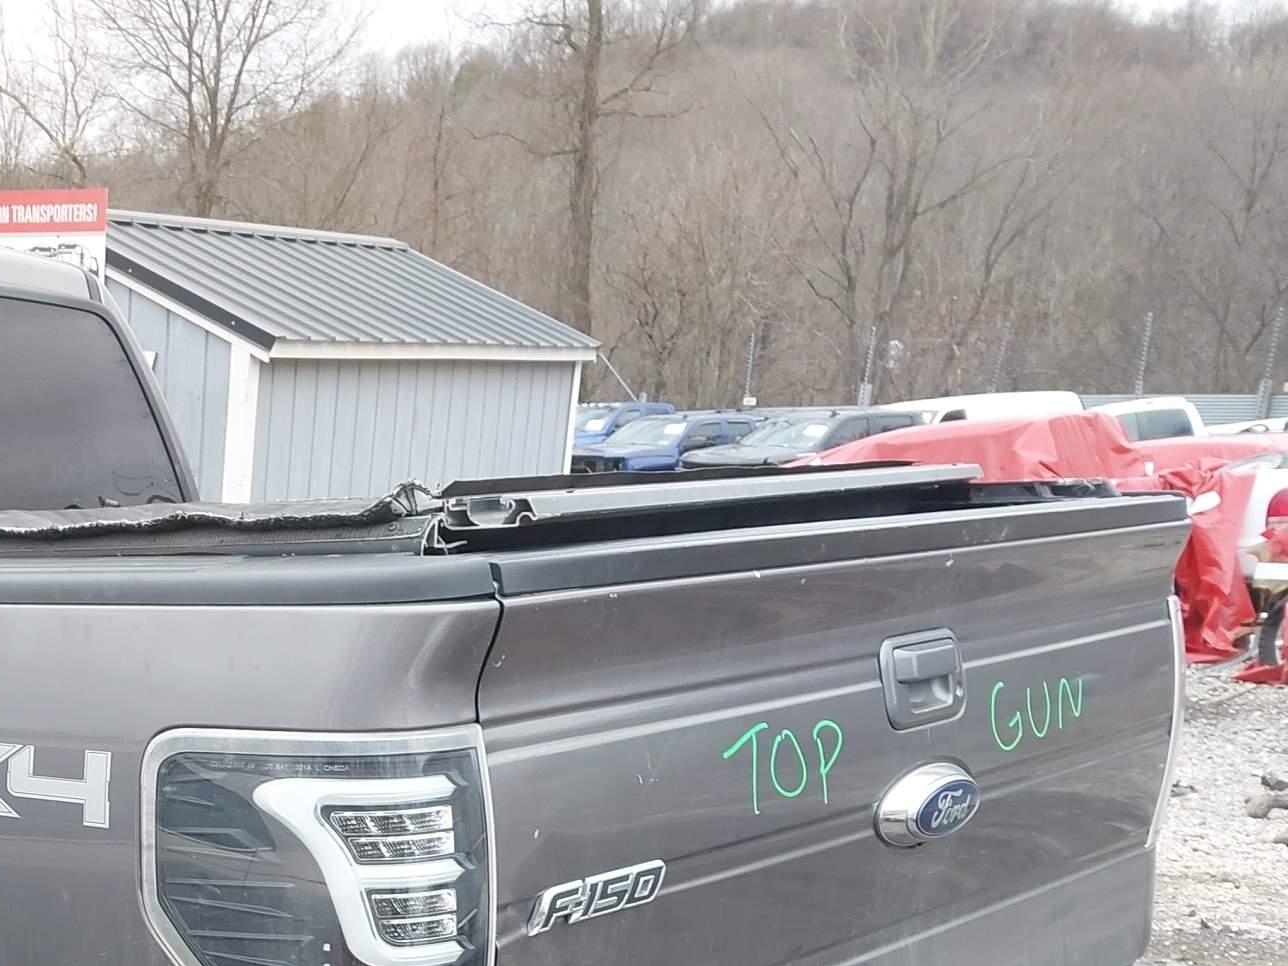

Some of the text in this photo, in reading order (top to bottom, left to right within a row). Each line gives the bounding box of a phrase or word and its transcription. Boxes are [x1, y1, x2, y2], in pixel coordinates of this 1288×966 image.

[11, 203, 98, 223] TRANSPORTERS!
[722, 676, 1084, 815] TOP GUN
[930, 788, 972, 829] Ford
[527, 859, 667, 937] F-150
